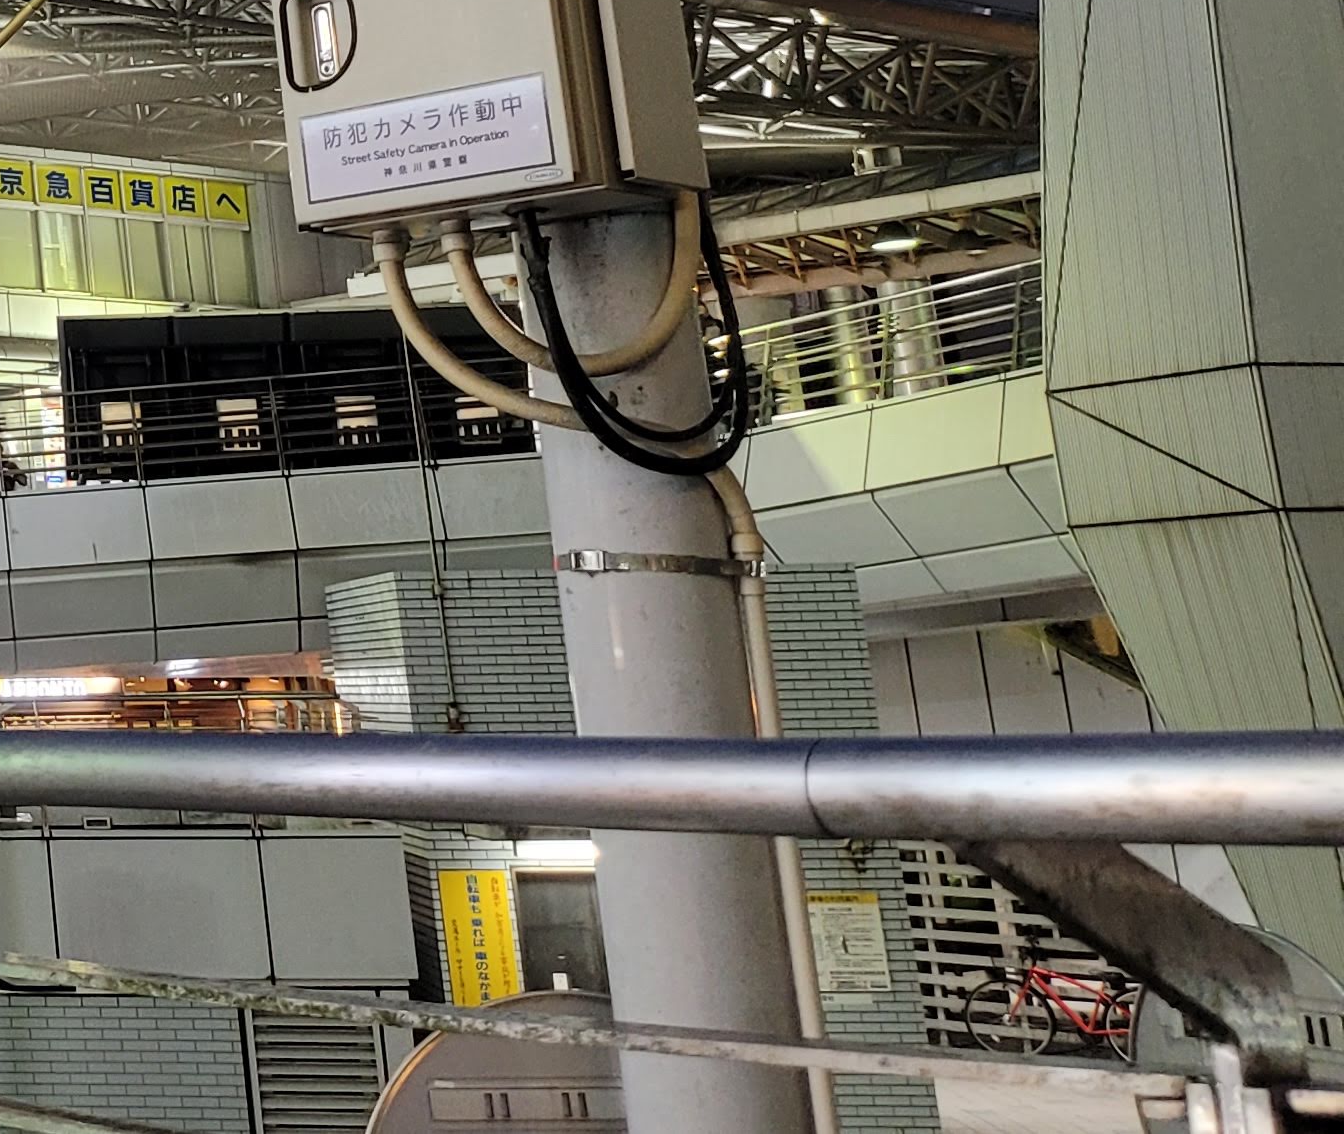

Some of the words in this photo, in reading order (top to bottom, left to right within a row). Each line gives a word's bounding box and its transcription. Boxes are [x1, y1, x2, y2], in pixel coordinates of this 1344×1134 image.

[323, 92, 522, 151] 防犯カメラ作動中
[341, 152, 372, 166] Street
[373, 147, 406, 161] Safety
[408, 140, 447, 154] Camera
[459, 129, 510, 146] Operation
[466, 874, 482, 914] 自転車も
